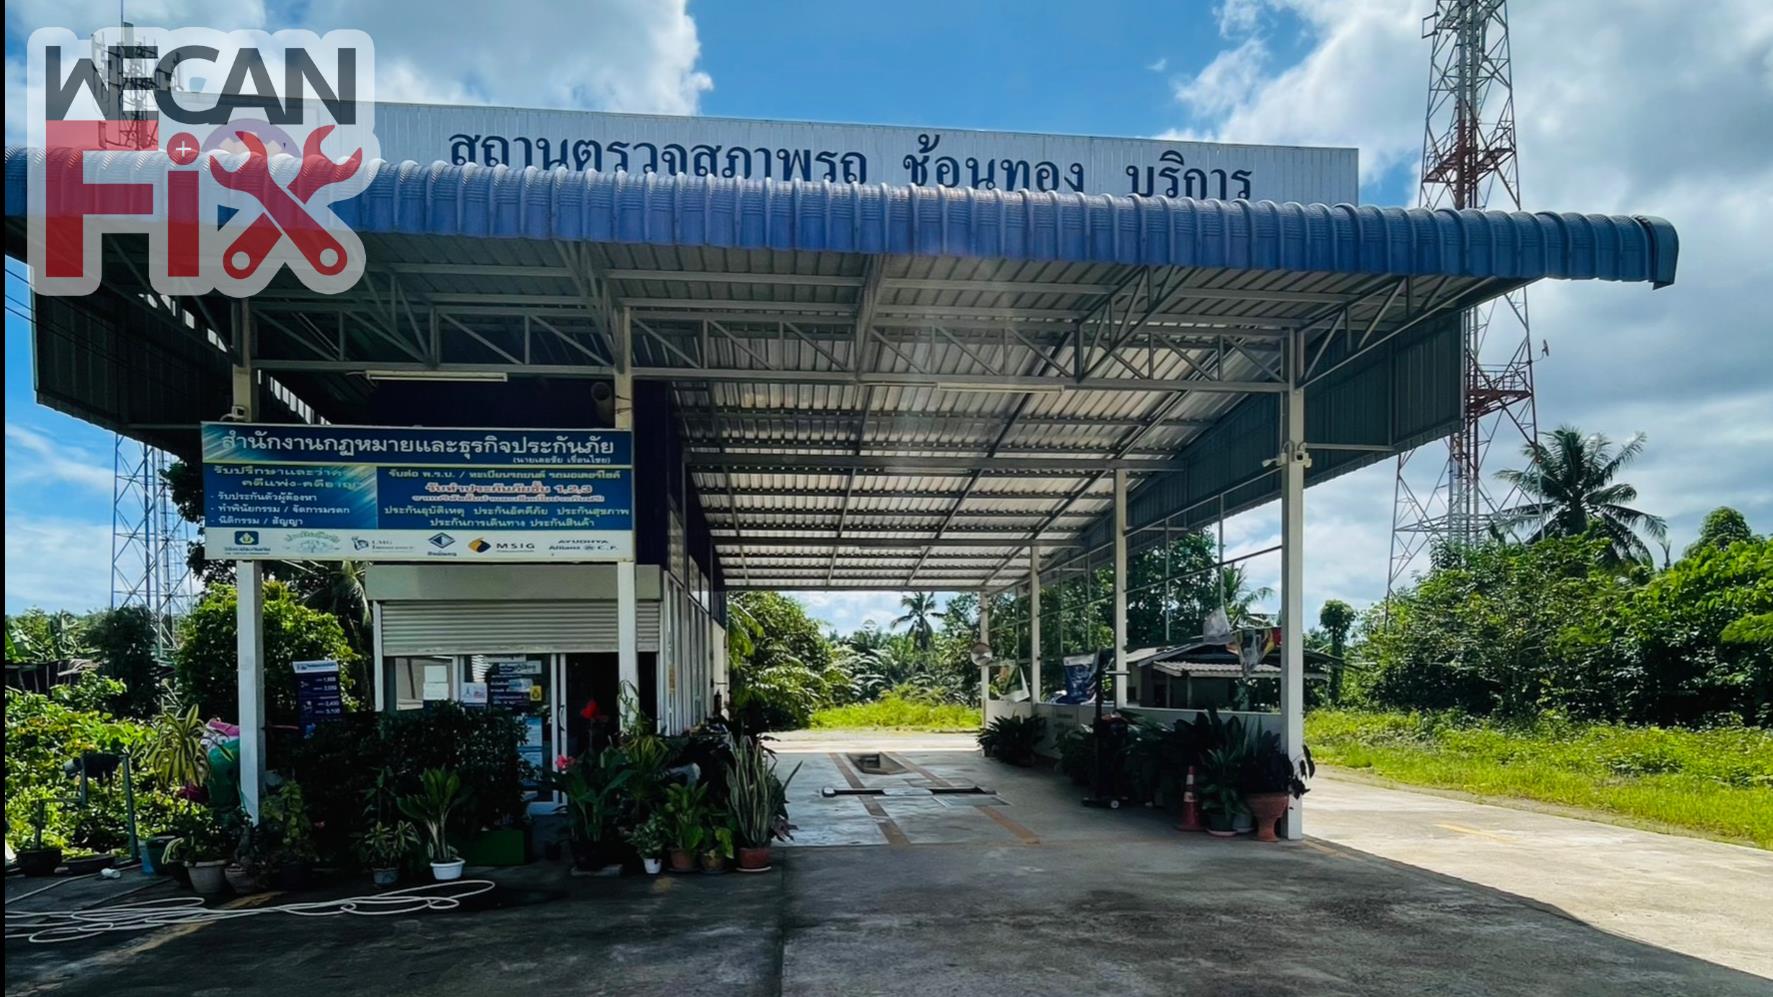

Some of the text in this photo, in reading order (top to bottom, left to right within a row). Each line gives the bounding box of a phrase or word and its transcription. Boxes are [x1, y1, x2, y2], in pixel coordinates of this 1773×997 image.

[449, 134, 1252, 200] สถานตรวจสภาพรถ ช้อนทอง บริการ
[496, 542, 535, 550] MSIG
